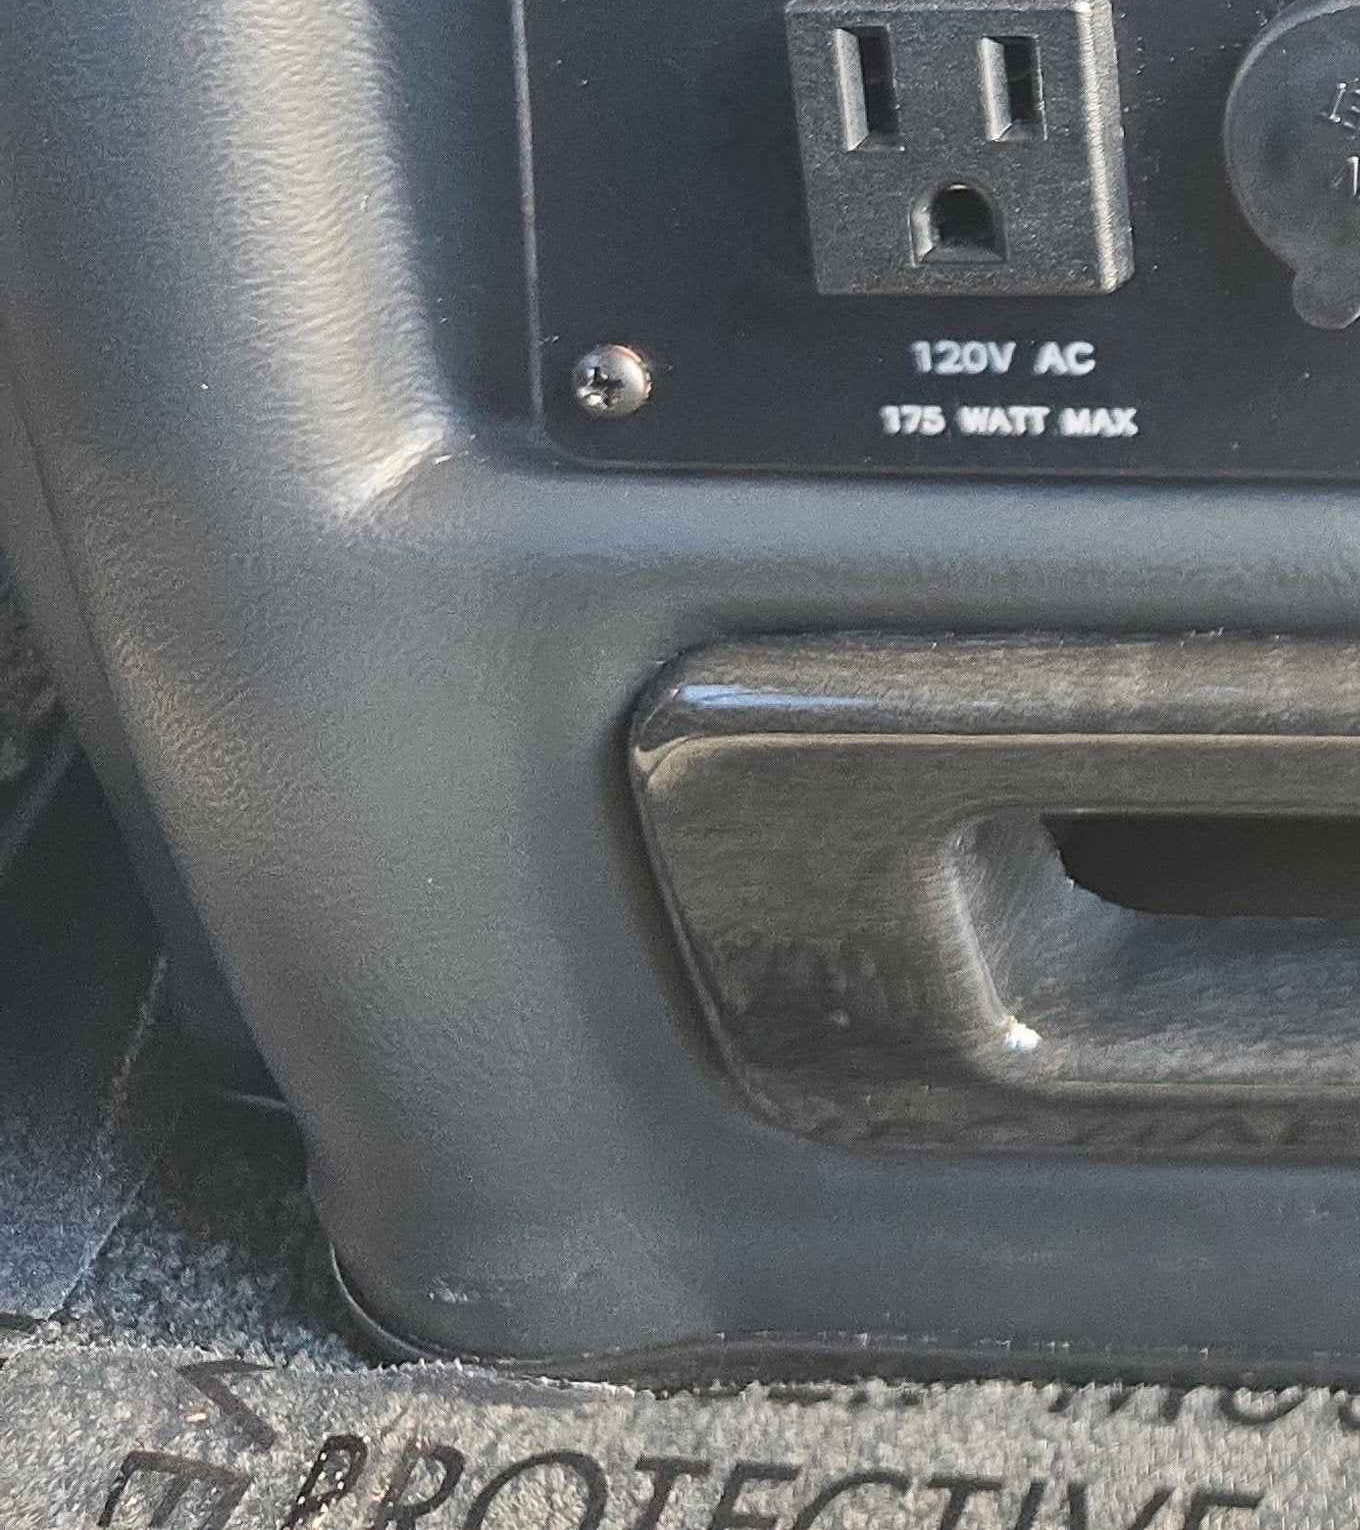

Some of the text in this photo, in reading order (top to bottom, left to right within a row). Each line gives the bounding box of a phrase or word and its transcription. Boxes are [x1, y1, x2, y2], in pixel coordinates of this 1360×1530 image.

[911, 339, 1096, 376] 120V AC
[880, 404, 1139, 437] 175 WATT MAX
